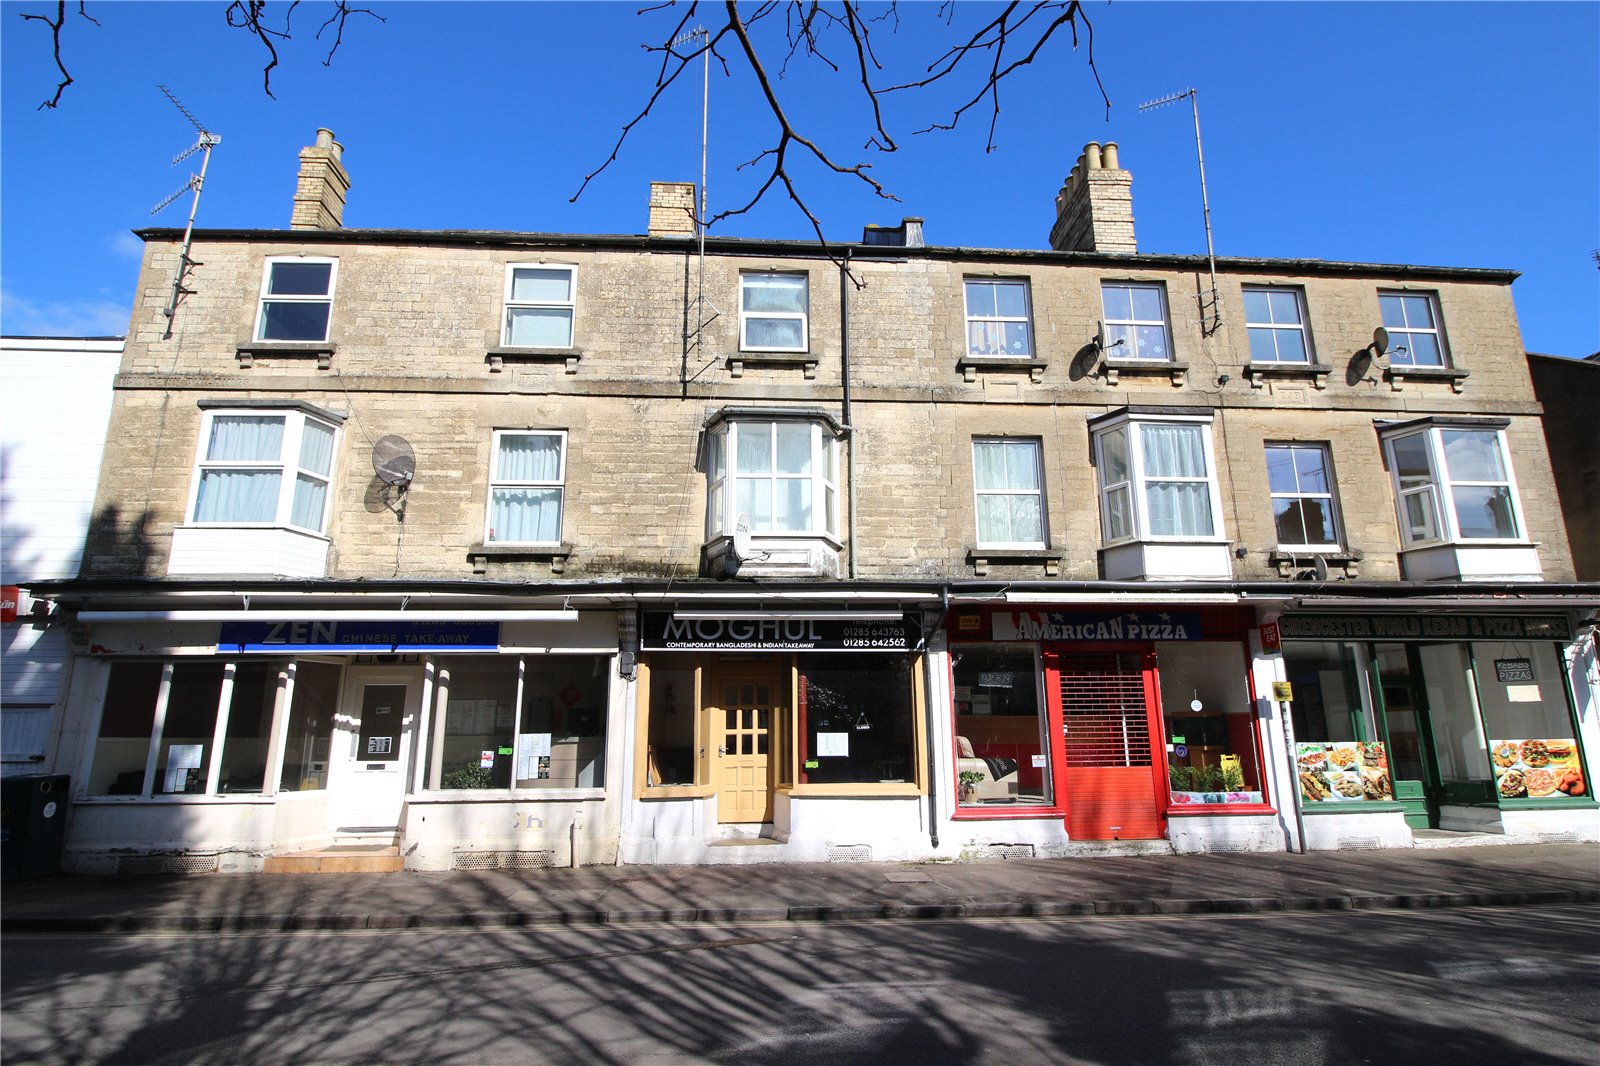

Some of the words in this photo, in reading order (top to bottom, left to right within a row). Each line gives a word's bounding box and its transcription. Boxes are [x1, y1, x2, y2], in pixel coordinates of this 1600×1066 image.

[148, 376, 181, 386] TOWN
[186, 377, 249, 387] BUILDINGS
[662, 614, 823, 641] MOGHUL
[843, 627, 870, 636] 01285
[871, 627, 905, 636] 643763
[1016, 615, 1123, 640] AMERICAN
[1127, 624, 1188, 640] PIZZA
[1263, 625, 1275, 635] JUST
[1280, 617, 1371, 636] CIRENCESTER
[1372, 617, 1420, 636] WORLD
[1423, 617, 1468, 636] KEBAB
[1471, 618, 1483, 636] &
[1484, 618, 1523, 636] PIZZA
[1525, 618, 1569, 637] HOUSE
[262, 621, 339, 644] ZEN
[342, 634, 397, 643] CHINESE
[405, 634, 470, 643] TAKE-AWAY
[843, 637, 870, 647] 01285
[871, 637, 906, 647] 642562
[1266, 634, 1277, 642] EAT
[666, 641, 716, 649] CONTEMPORARY
[716, 641, 757, 649] BANGLADESHI
[1496, 661, 1530, 670] KEBABS
[1499, 670, 1533, 680] PIZZAS
